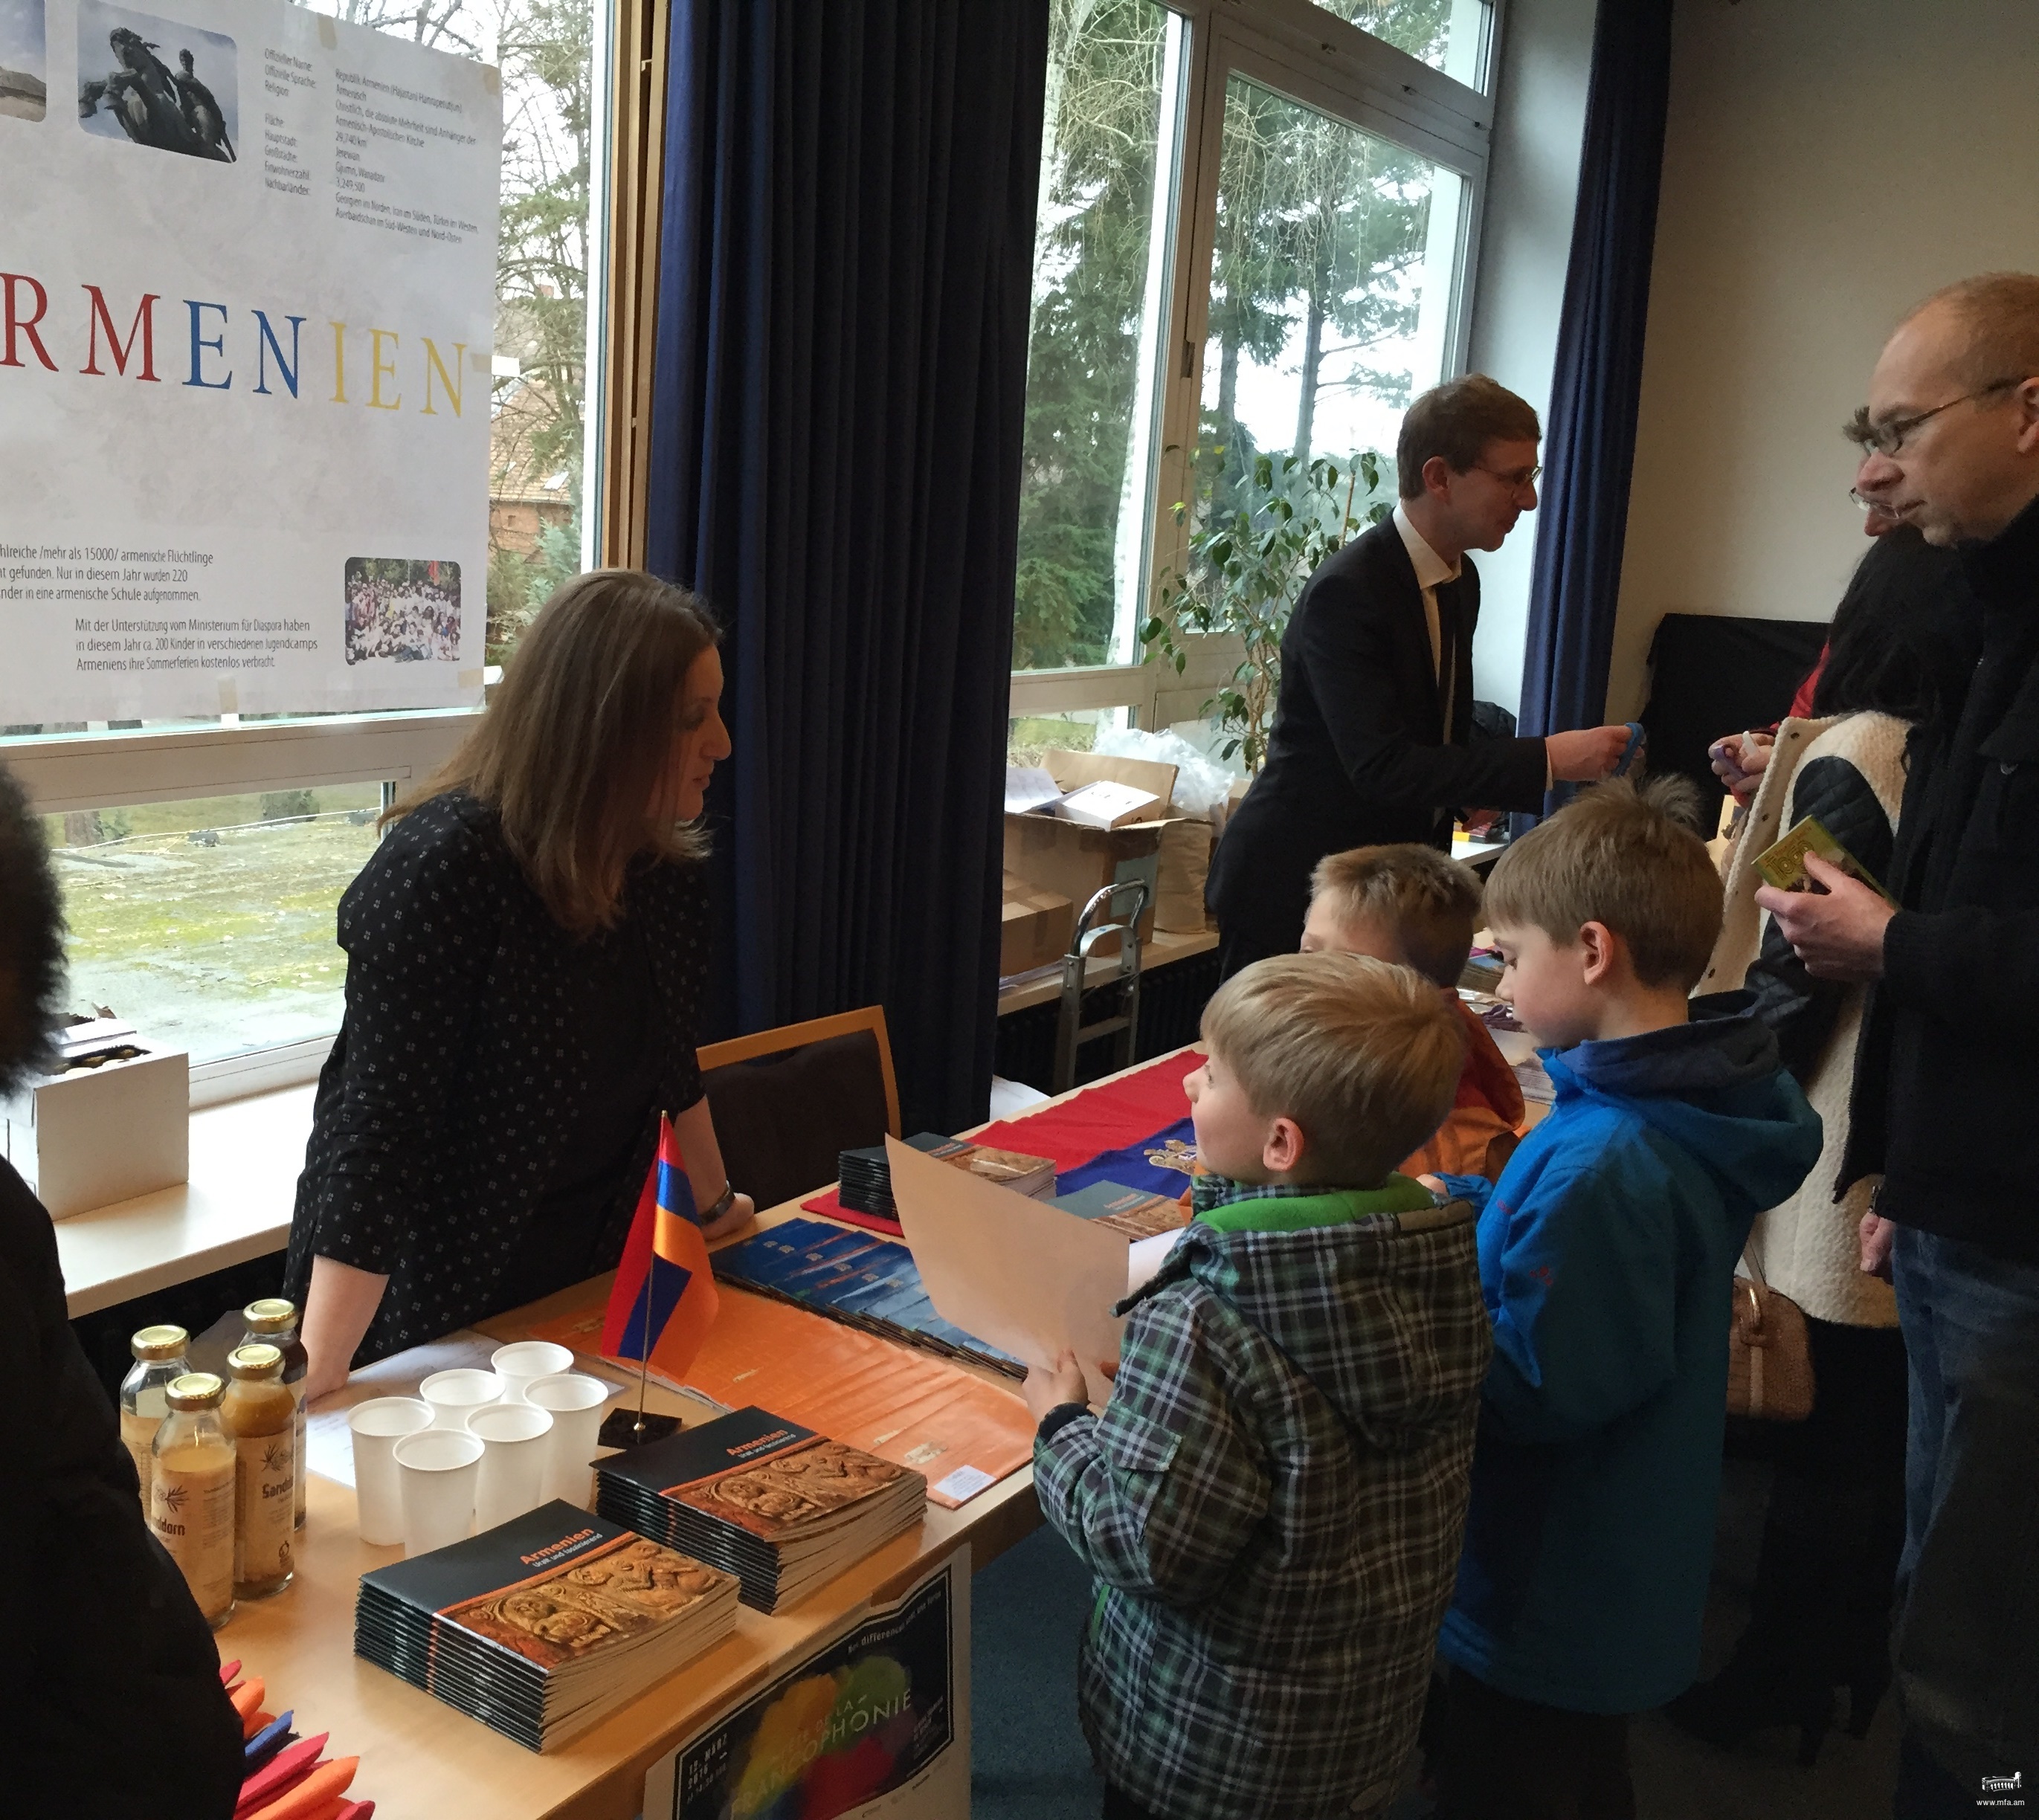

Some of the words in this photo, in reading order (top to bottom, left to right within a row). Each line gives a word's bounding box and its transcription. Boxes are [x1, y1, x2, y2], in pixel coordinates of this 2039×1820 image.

[335, 68, 361, 85] Republik
[362, 76, 390, 93] Armenien
[336, 84, 367, 101] Armenisch
[335, 192, 362, 207] Georgien
[419, 228, 431, 237] und
[0, 543, 37, 559] hlreiche
[68, 546, 82, 560] als
[121, 549, 166, 562] armenische
[168, 549, 213, 567] Flüchtlinge
[9, 565, 54, 582] gefunden.
[57, 567, 72, 579] Nur
[75, 568, 84, 580] in
[86, 567, 120, 581] diesem
[123, 568, 141, 581] Jahr
[143, 569, 170, 582] wurden
[173, 569, 188, 582] 220
[25, 587, 34, 599] in
[36, 587, 54, 600] eine
[56, 587, 109, 600] armenische
[111, 587, 142, 601] Schule
[144, 587, 202, 604] aufgenommen.
[75, 618, 91, 631] Mit
[94, 619, 109, 631] der
[112, 619, 169, 634] Unterstützung
[170, 620, 187, 631] vom
[188, 619, 239, 631] Ministerium
[241, 619, 253, 631] für
[254, 619, 282, 633] Diaspora
[283, 618, 310, 631] haben
[76, 639, 85, 651] in
[87, 638, 121, 651] diesem
[123, 638, 142, 651] Jahr
[143, 640, 154, 651] ca.
[155, 637, 169, 651] 200
[170, 637, 195, 650] Kinder
[197, 638, 205, 649] in
[207, 637, 263, 650] verschiedenen
[265, 637, 318, 652] Jugendcamps
[76, 657, 127, 671] Armeniens
[129, 657, 145, 670] ihre
[146, 655, 199, 670] Sommerferien
[201, 655, 240, 668] kostenlos
[726, 1429, 789, 1456] Armenien
[520, 1529, 595, 1565] Armenien
